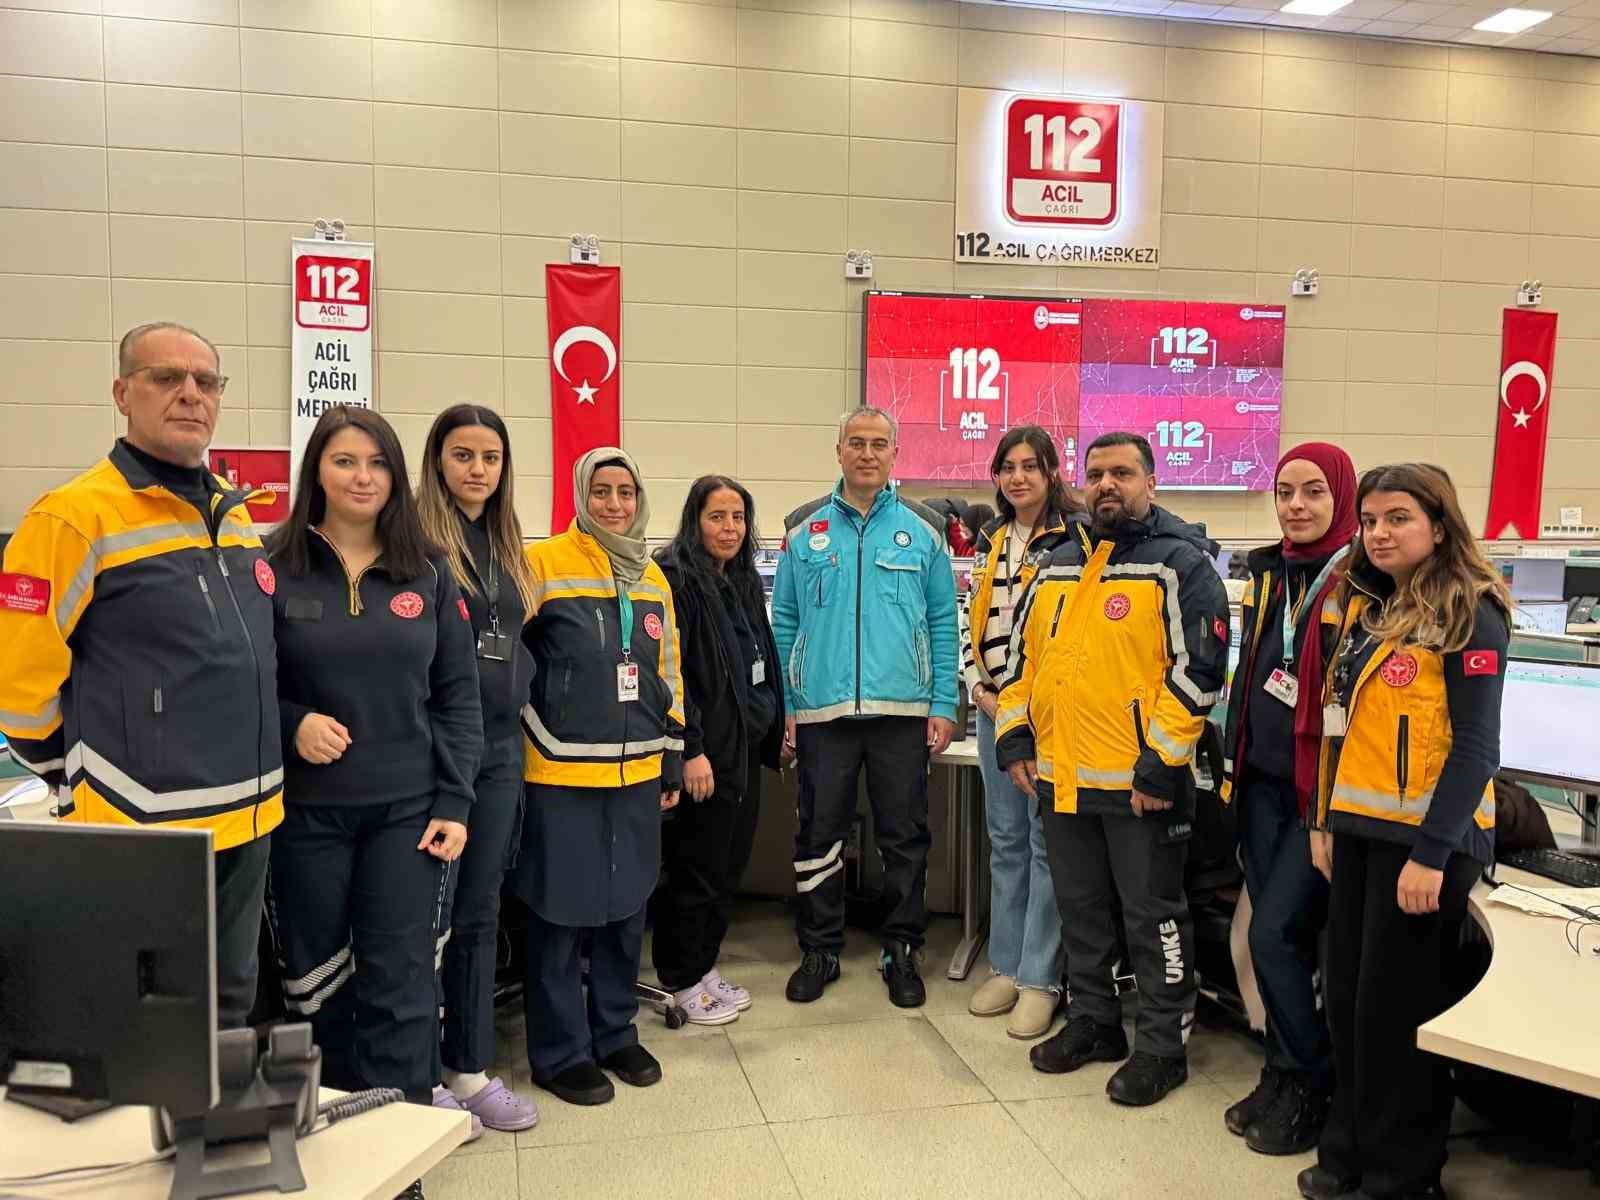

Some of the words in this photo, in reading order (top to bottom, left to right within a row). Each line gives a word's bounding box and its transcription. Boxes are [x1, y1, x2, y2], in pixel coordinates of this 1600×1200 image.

[1024, 114, 1102, 174] 112
[956, 232, 991, 258] 112
[306, 264, 360, 301] 112
[314, 338, 351, 362] ACİL
[1160, 326, 1209, 354] 112
[308, 366, 357, 394] ÇAĞRI
[949, 347, 1001, 400] 112
[1156, 420, 1205, 448] 112
[1158, 919, 1185, 985] UMKE
